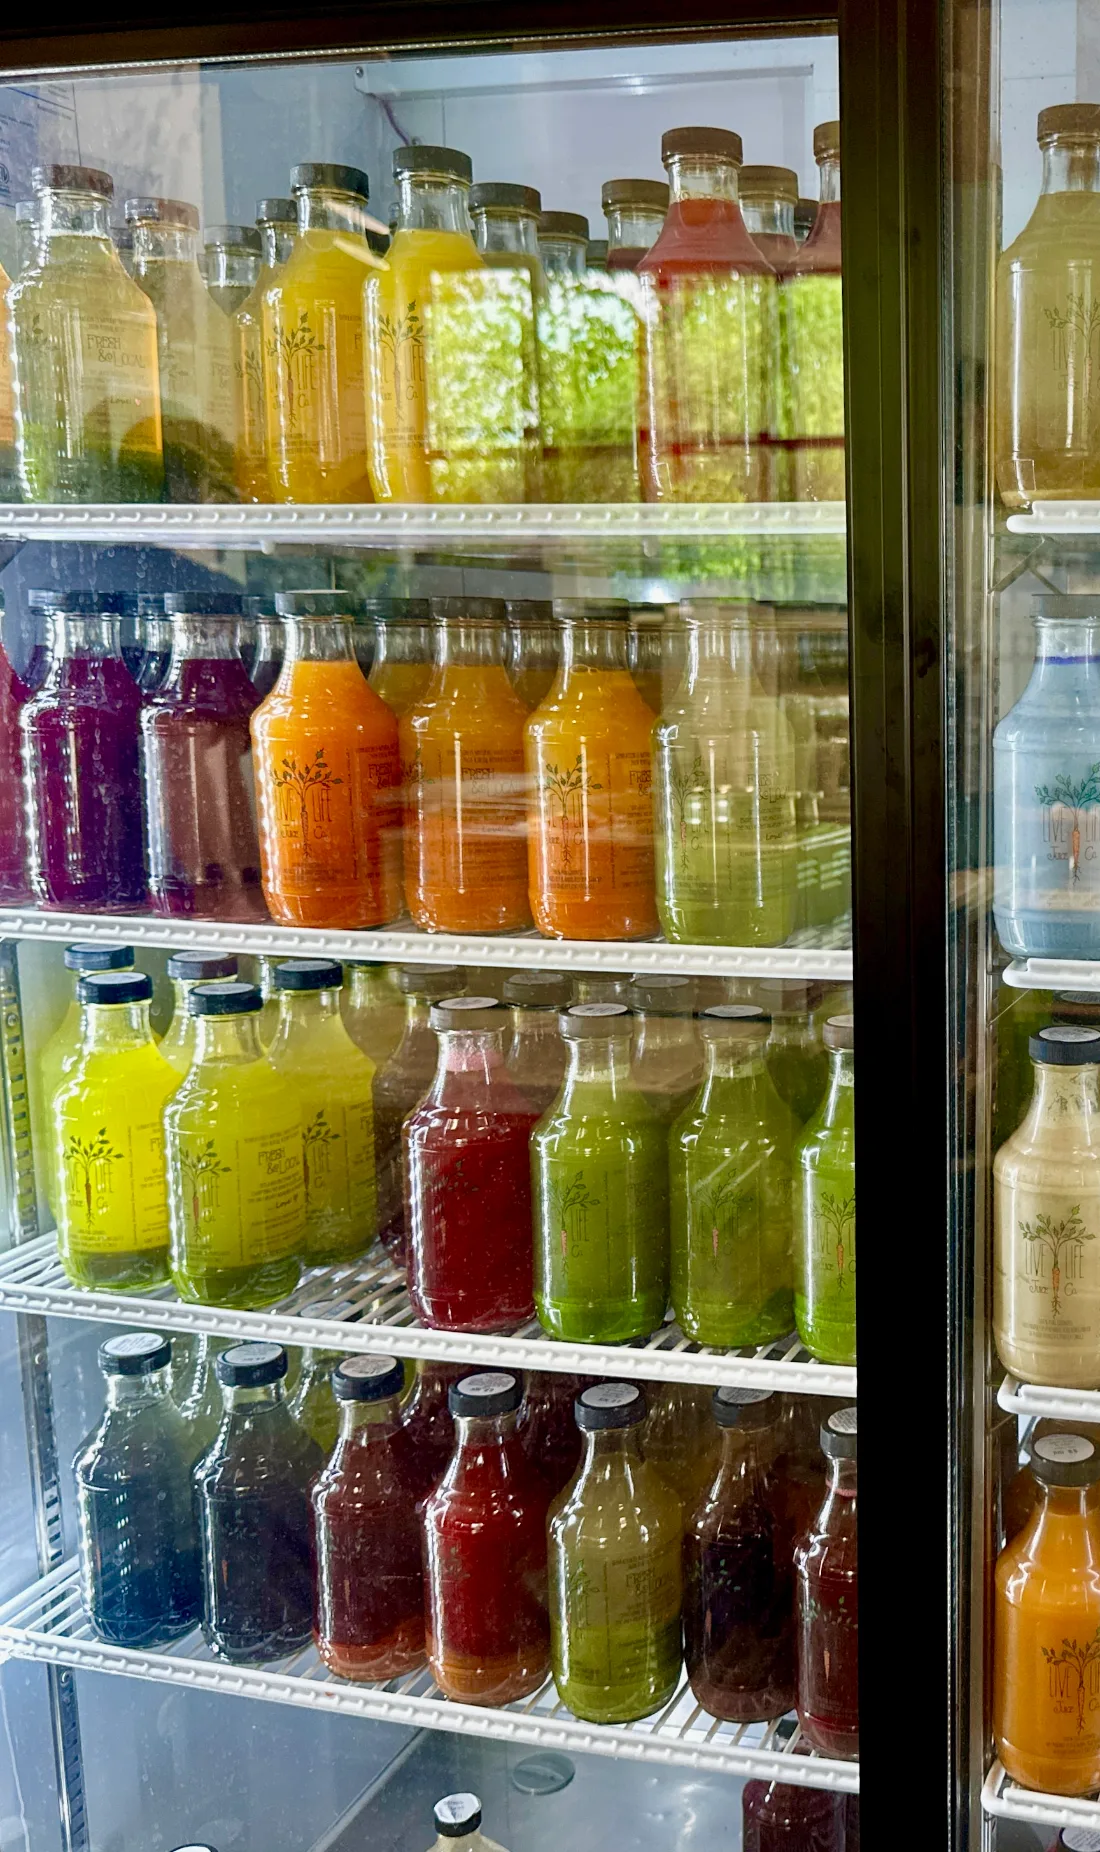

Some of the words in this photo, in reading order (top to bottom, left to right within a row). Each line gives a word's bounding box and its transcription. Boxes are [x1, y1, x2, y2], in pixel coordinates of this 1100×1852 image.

[87, 334, 121, 350] FRESH
[296, 355, 316, 390] LIFE
[461, 767, 495, 782] FRESH
[312, 788, 333, 822] LIFE
[1042, 806, 1066, 843] LIVE
[1046, 845, 1069, 862] Juice
[258, 1147, 286, 1166] FRESH
[95, 1162, 115, 1194] LIFE
[203, 1176, 221, 1210] LIFE
[571, 1208, 589, 1242] LIFE
[1025, 1243, 1048, 1278] LIVE
[1065, 1244, 1085, 1279] LIFE
[1029, 1279, 1049, 1294] Juice
[1048, 1665, 1072, 1698] LIVE
